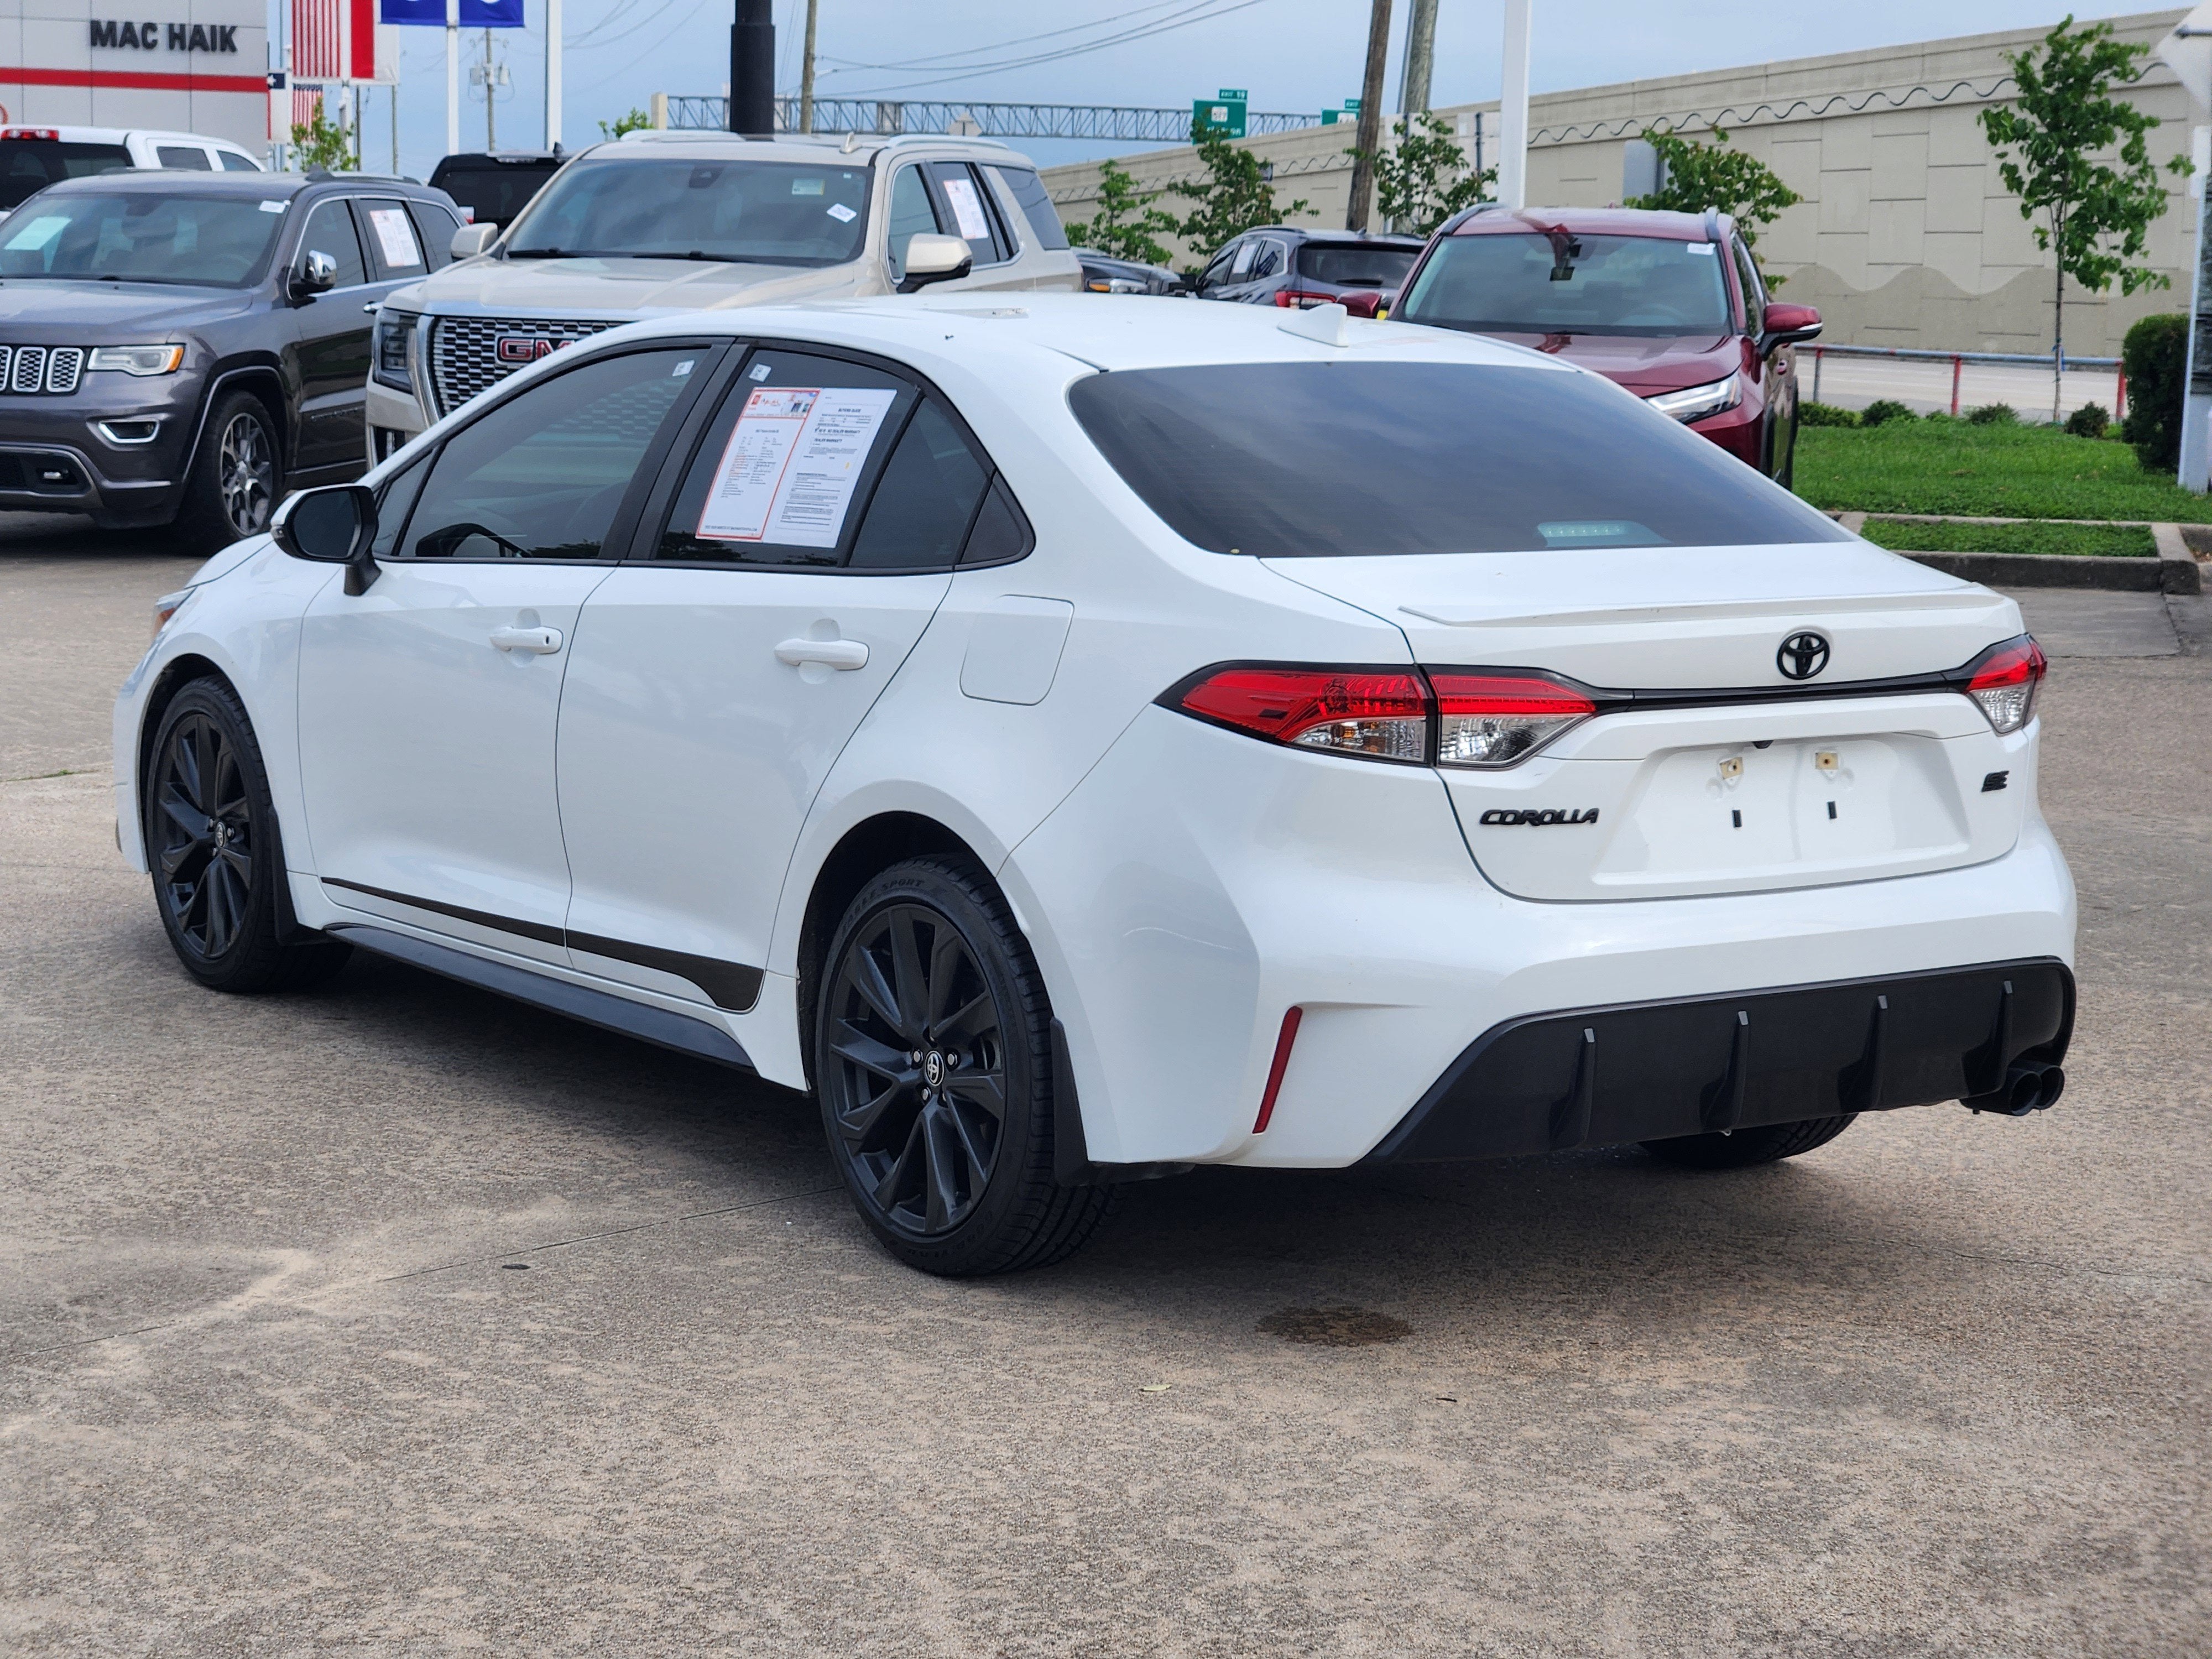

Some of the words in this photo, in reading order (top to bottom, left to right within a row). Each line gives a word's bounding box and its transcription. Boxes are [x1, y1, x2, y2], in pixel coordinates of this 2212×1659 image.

[90, 20, 158, 50] MAC
[168, 23, 238, 53] HAIK
[500, 338, 576, 361] GM
[1981, 770, 2010, 792] SE
[1479, 807, 1600, 826] COROLLA
[881, 878, 926, 890] SPORT
